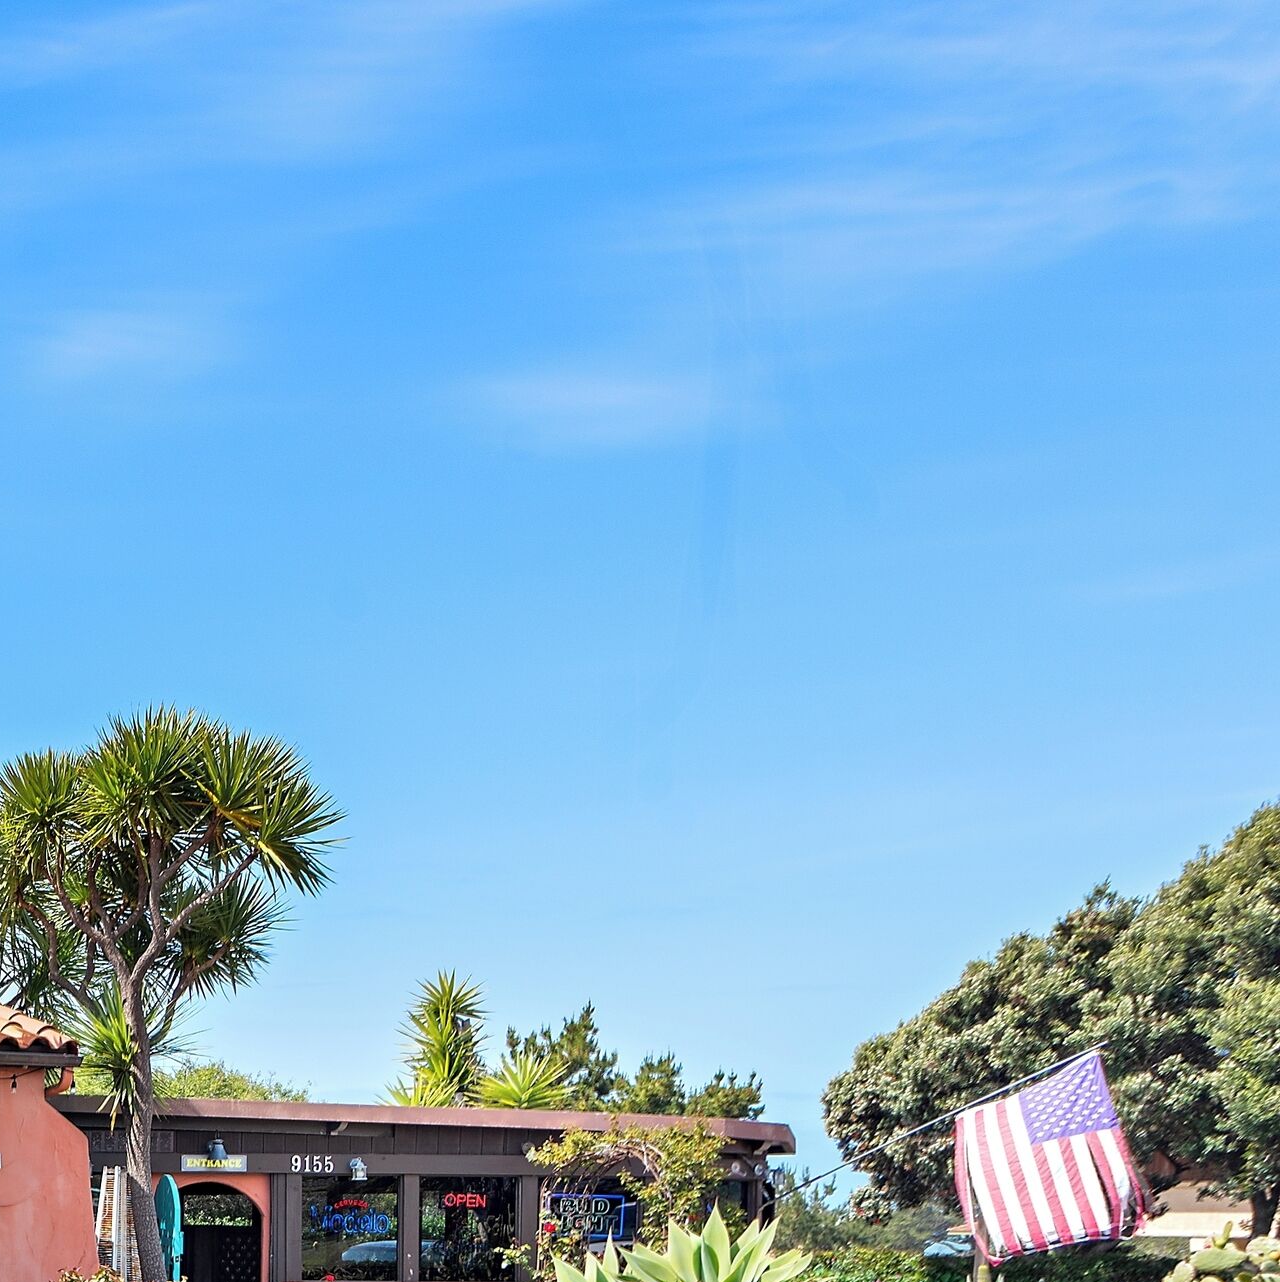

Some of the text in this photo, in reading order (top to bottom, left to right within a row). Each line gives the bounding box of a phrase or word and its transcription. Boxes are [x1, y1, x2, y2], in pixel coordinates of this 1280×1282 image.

[186, 1158, 242, 1169] ENTRANCE
[291, 1155, 334, 1173] 9155
[333, 1199, 369, 1209] CERVEZA
[444, 1192, 487, 1208] OPEN
[559, 1197, 610, 1215] BUD
